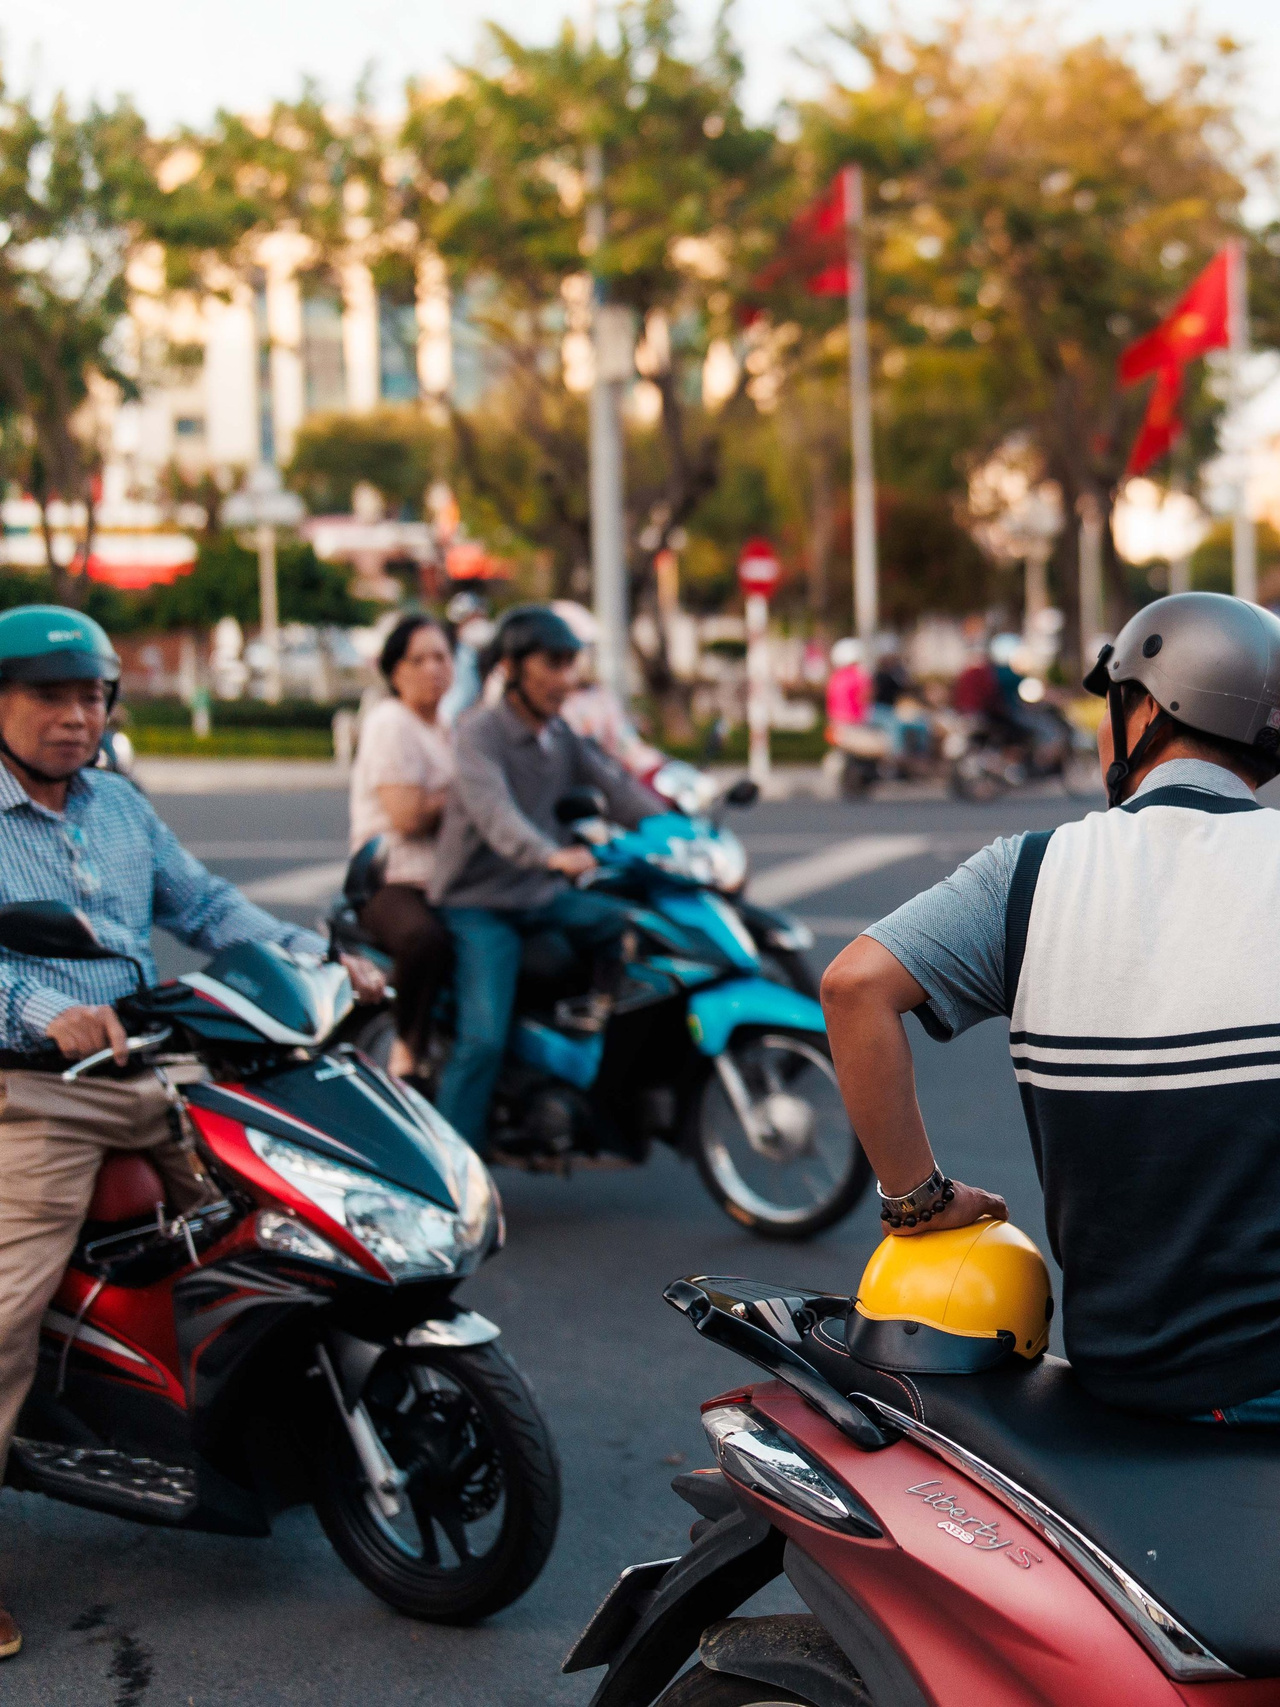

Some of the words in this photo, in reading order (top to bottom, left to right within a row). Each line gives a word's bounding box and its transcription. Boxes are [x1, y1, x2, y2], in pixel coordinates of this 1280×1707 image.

[906, 1480, 1013, 1550] Liberty
[1005, 1547, 1042, 1569] S
[937, 1521, 974, 1544] ABS
